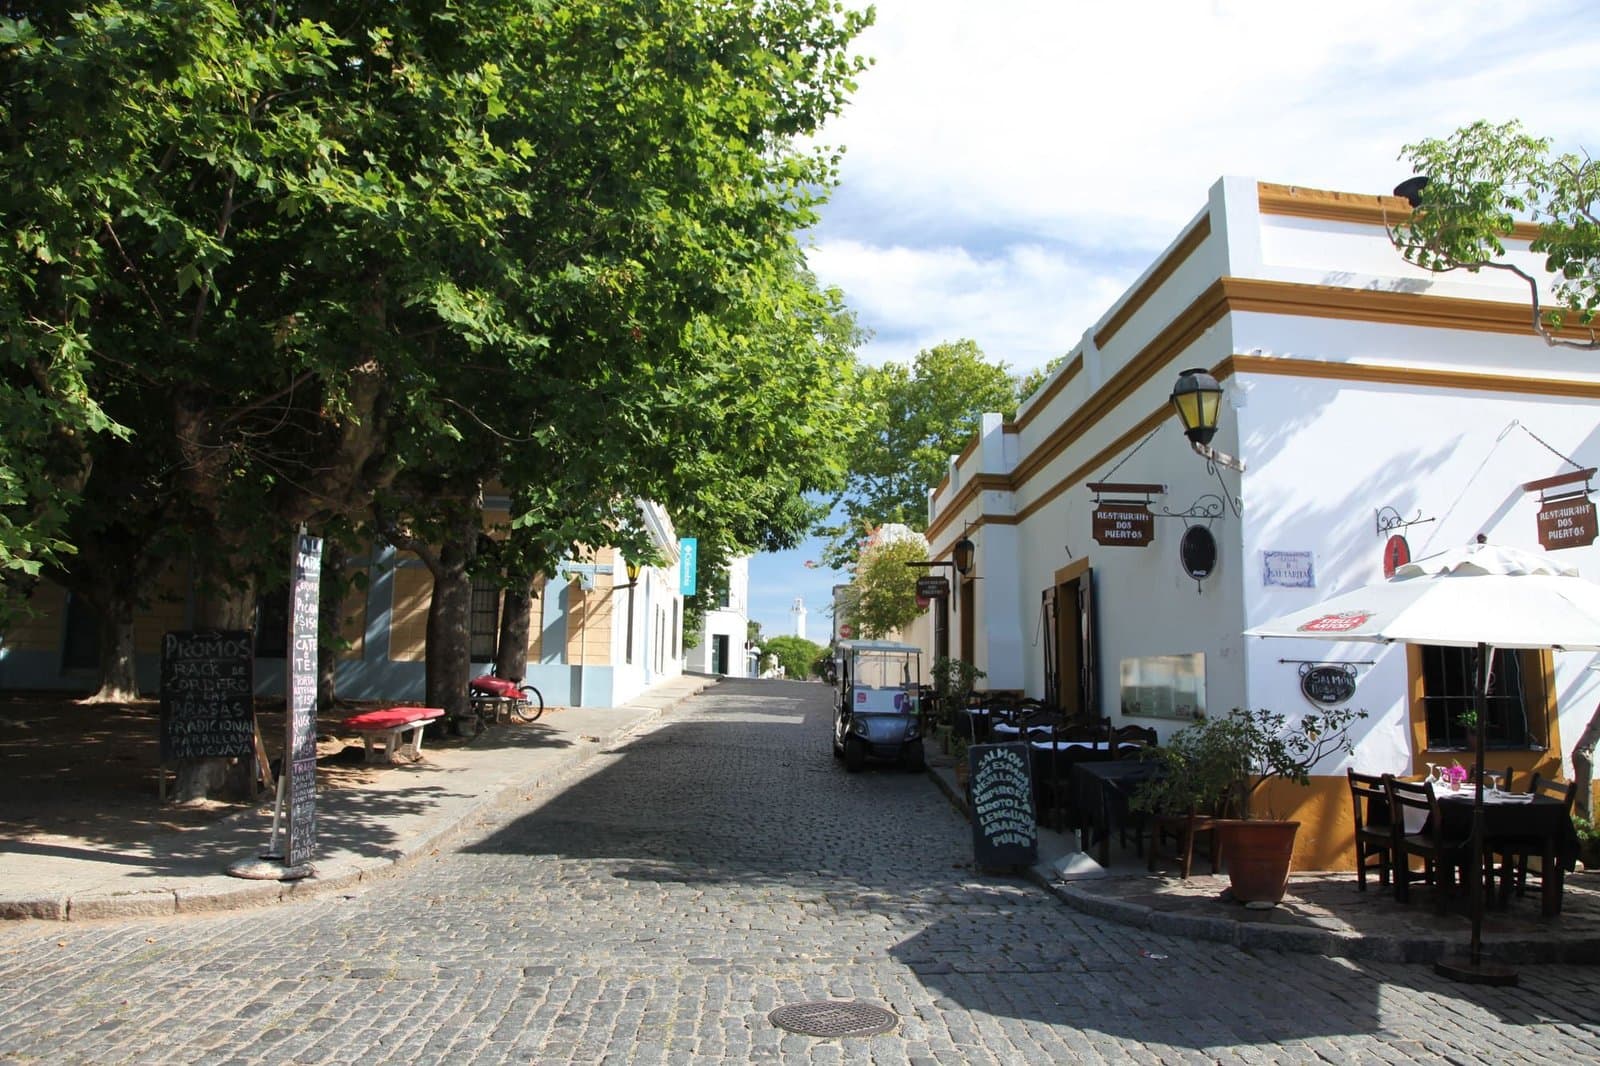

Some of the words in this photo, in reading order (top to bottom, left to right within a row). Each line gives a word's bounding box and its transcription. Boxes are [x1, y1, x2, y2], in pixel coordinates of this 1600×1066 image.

[1116, 521, 1132, 530] DOS
[1557, 518, 1573, 528] DOS
[1104, 529, 1143, 539] PUERTOS
[1548, 526, 1585, 541] PUERTOS
[165, 633, 251, 661] PROMOS
[978, 748, 1024, 769] SALMON
[976, 799, 1032, 814] BROTOLA
[993, 832, 1031, 848] PULPO
